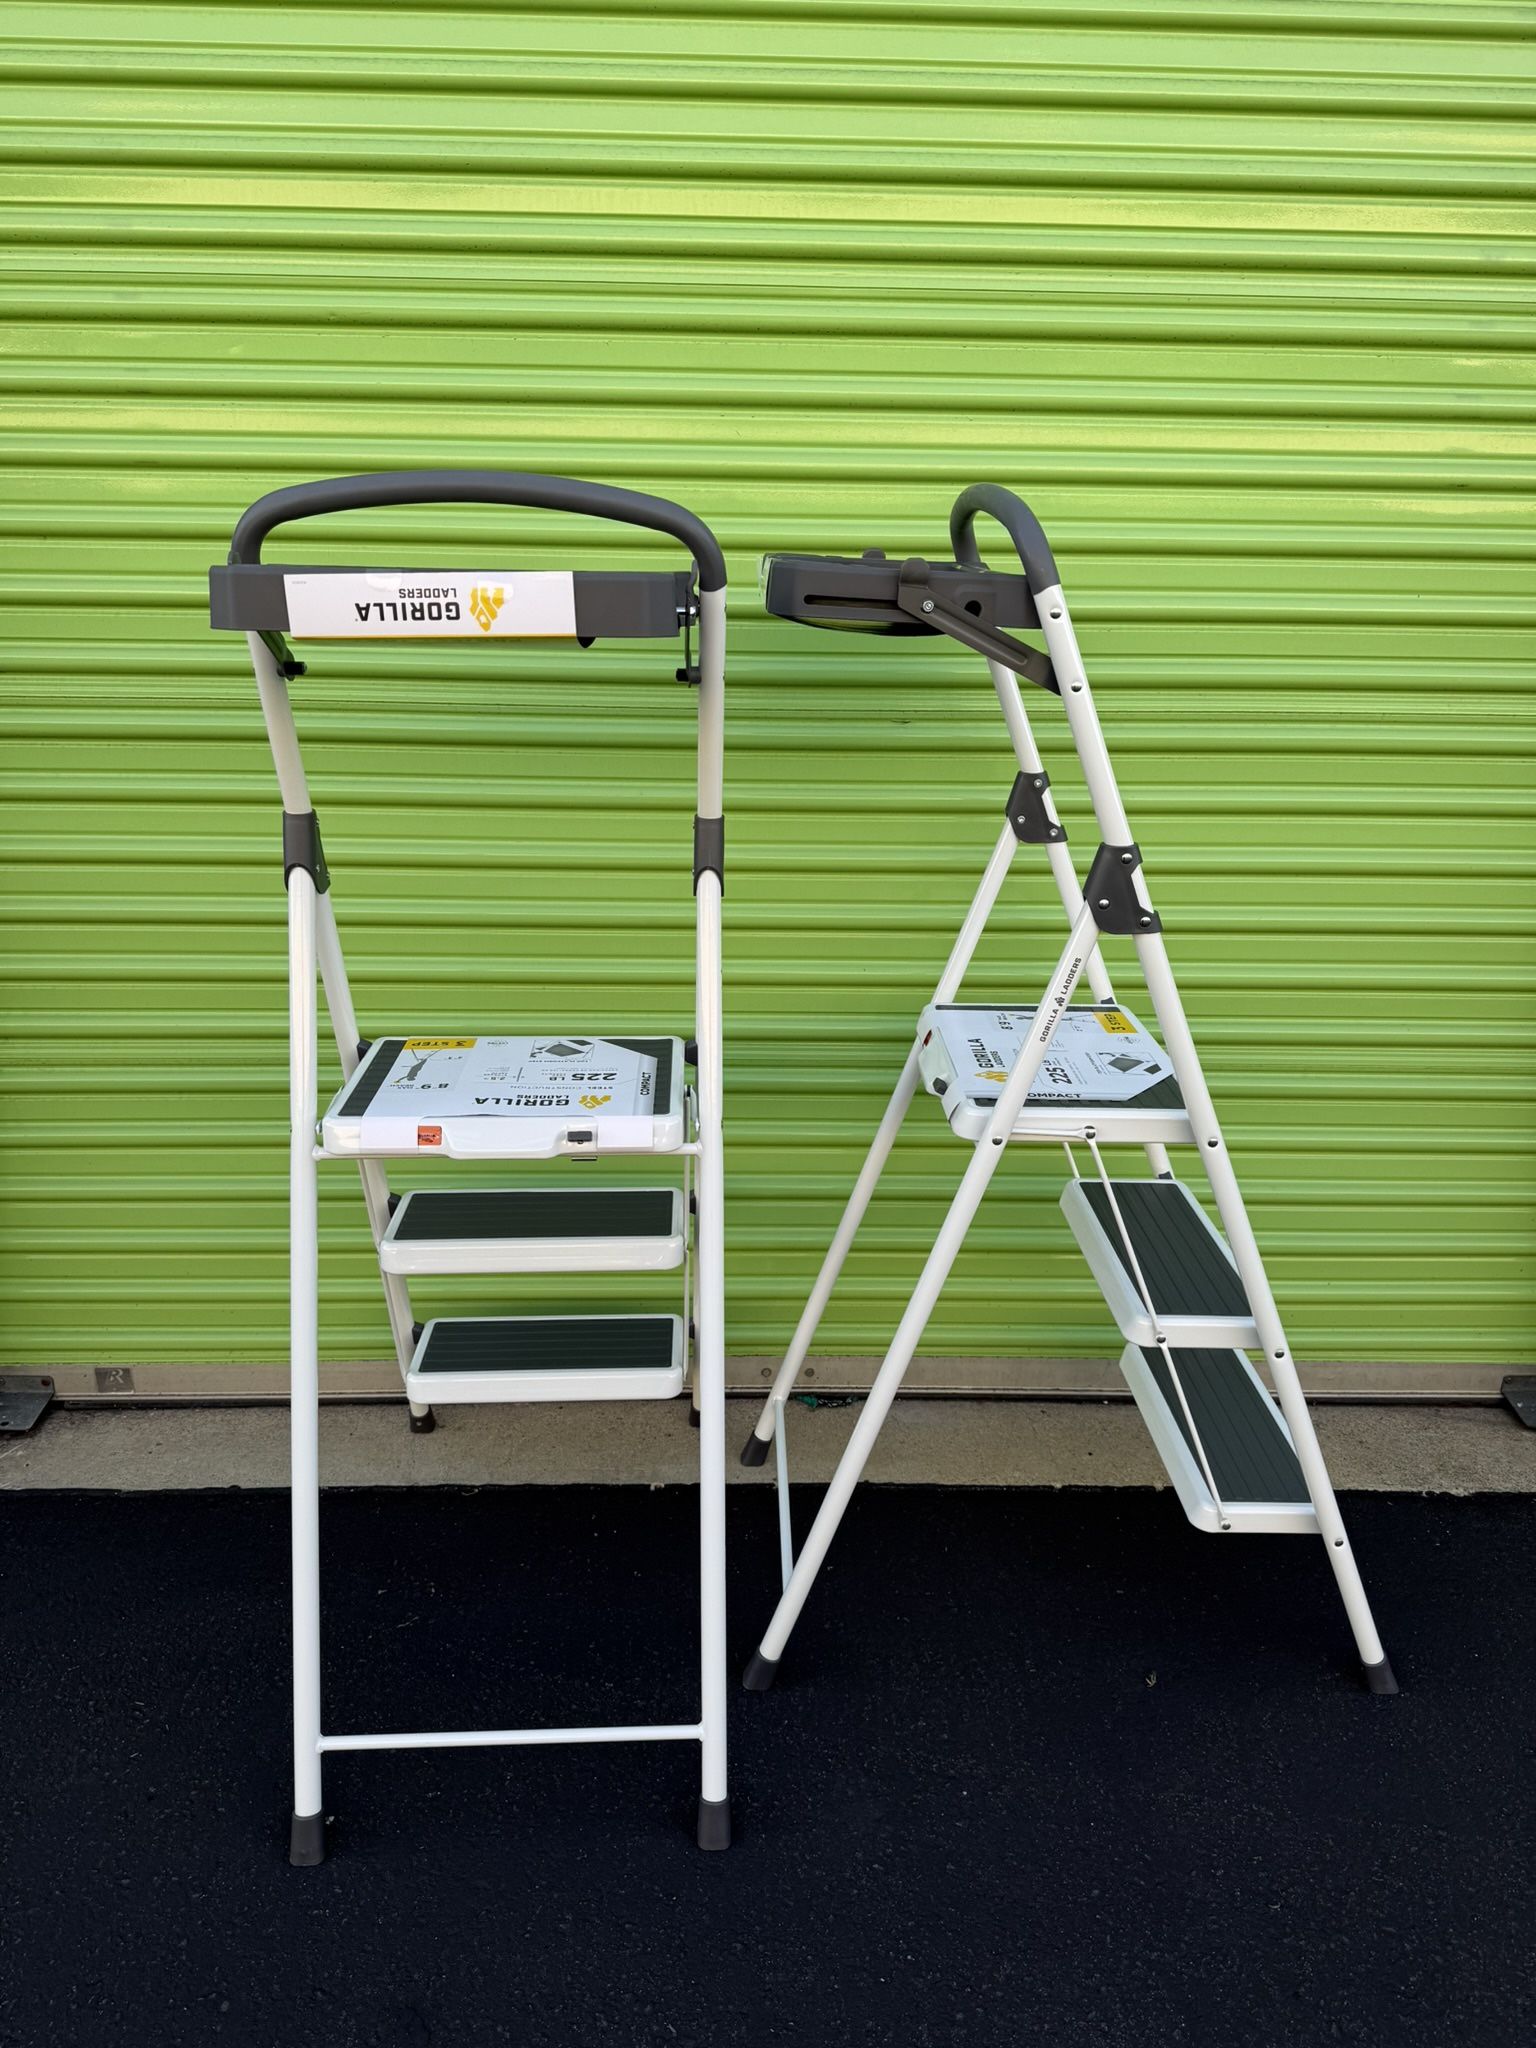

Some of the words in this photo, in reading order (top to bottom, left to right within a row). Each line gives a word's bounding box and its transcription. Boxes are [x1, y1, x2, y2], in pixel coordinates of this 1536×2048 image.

[399, 588, 457, 599] LADDERS
[355, 601, 460, 622] GORILLA
[1039, 1008, 1059, 1043] GORILLA
[1061, 957, 1082, 995] LADDERS
[967, 1038, 994, 1068] GORILLA
[571, 1072, 617, 1081] 225
[640, 1072, 652, 1096] COMPACT
[1045, 1067, 1073, 1085] 225
[474, 1097, 570, 1107] GORILLA
